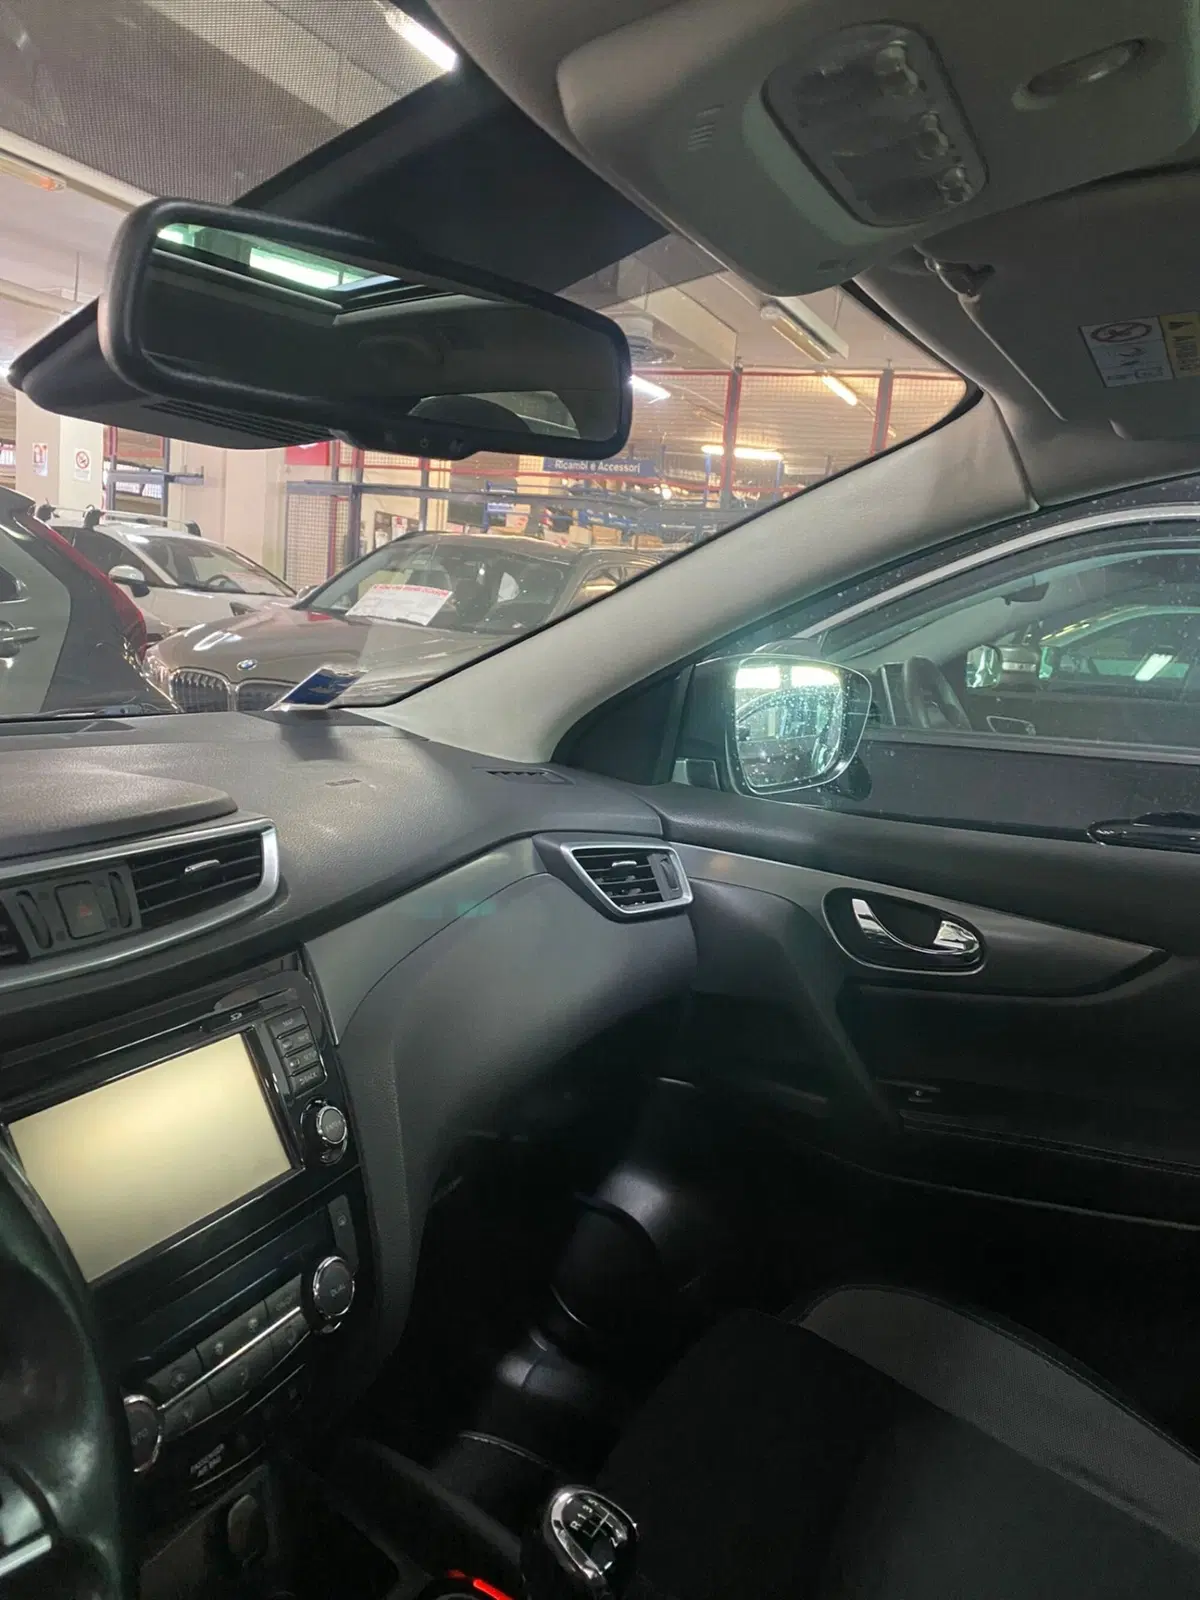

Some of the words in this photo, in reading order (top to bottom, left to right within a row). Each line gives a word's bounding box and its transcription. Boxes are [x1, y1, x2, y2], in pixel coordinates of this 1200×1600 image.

[554, 459, 588, 470] Ricambi
[590, 462, 597, 470] e
[598, 461, 641, 474] Accessori
[570, 1520, 582, 1531] R
[582, 1504, 593, 1513] 3
